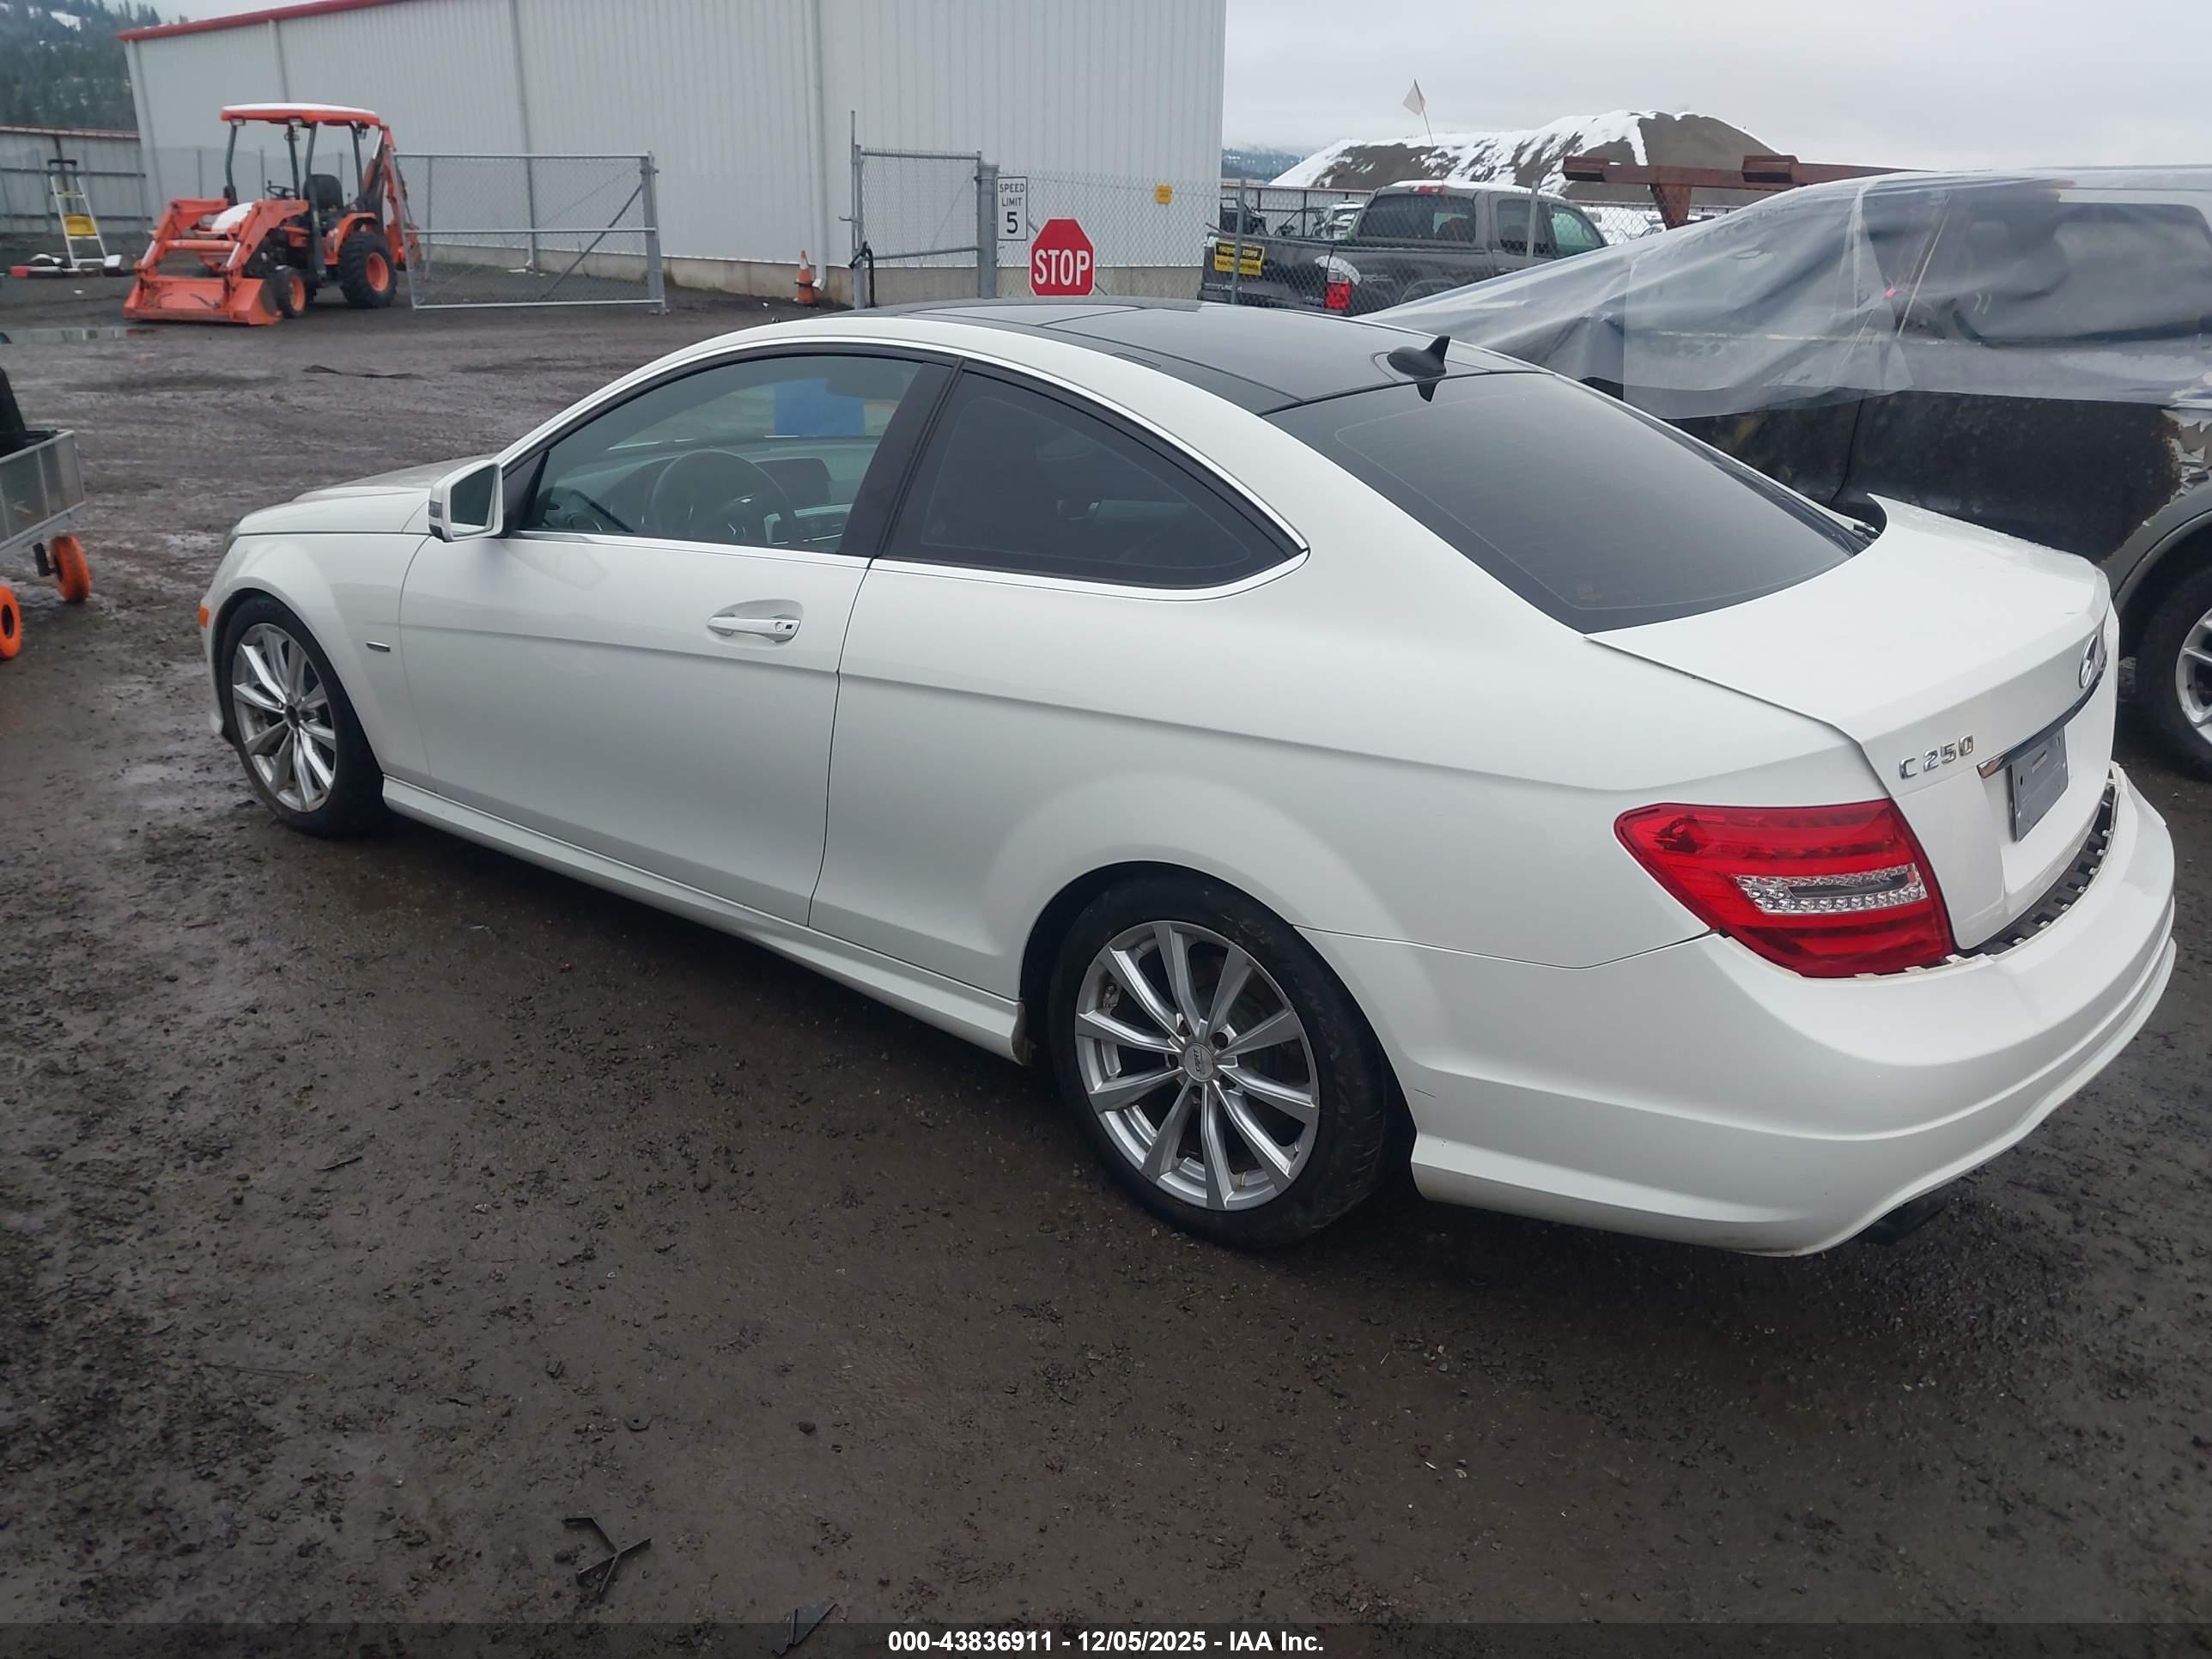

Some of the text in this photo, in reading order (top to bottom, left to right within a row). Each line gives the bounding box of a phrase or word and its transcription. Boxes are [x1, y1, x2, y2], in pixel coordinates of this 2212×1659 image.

[999, 183, 1025, 193] SPEED
[1001, 197, 1022, 207] LIMIT
[1006, 211, 1018, 234] 5
[1034, 249, 1091, 286] STOP
[1899, 735, 1974, 780] C 250
